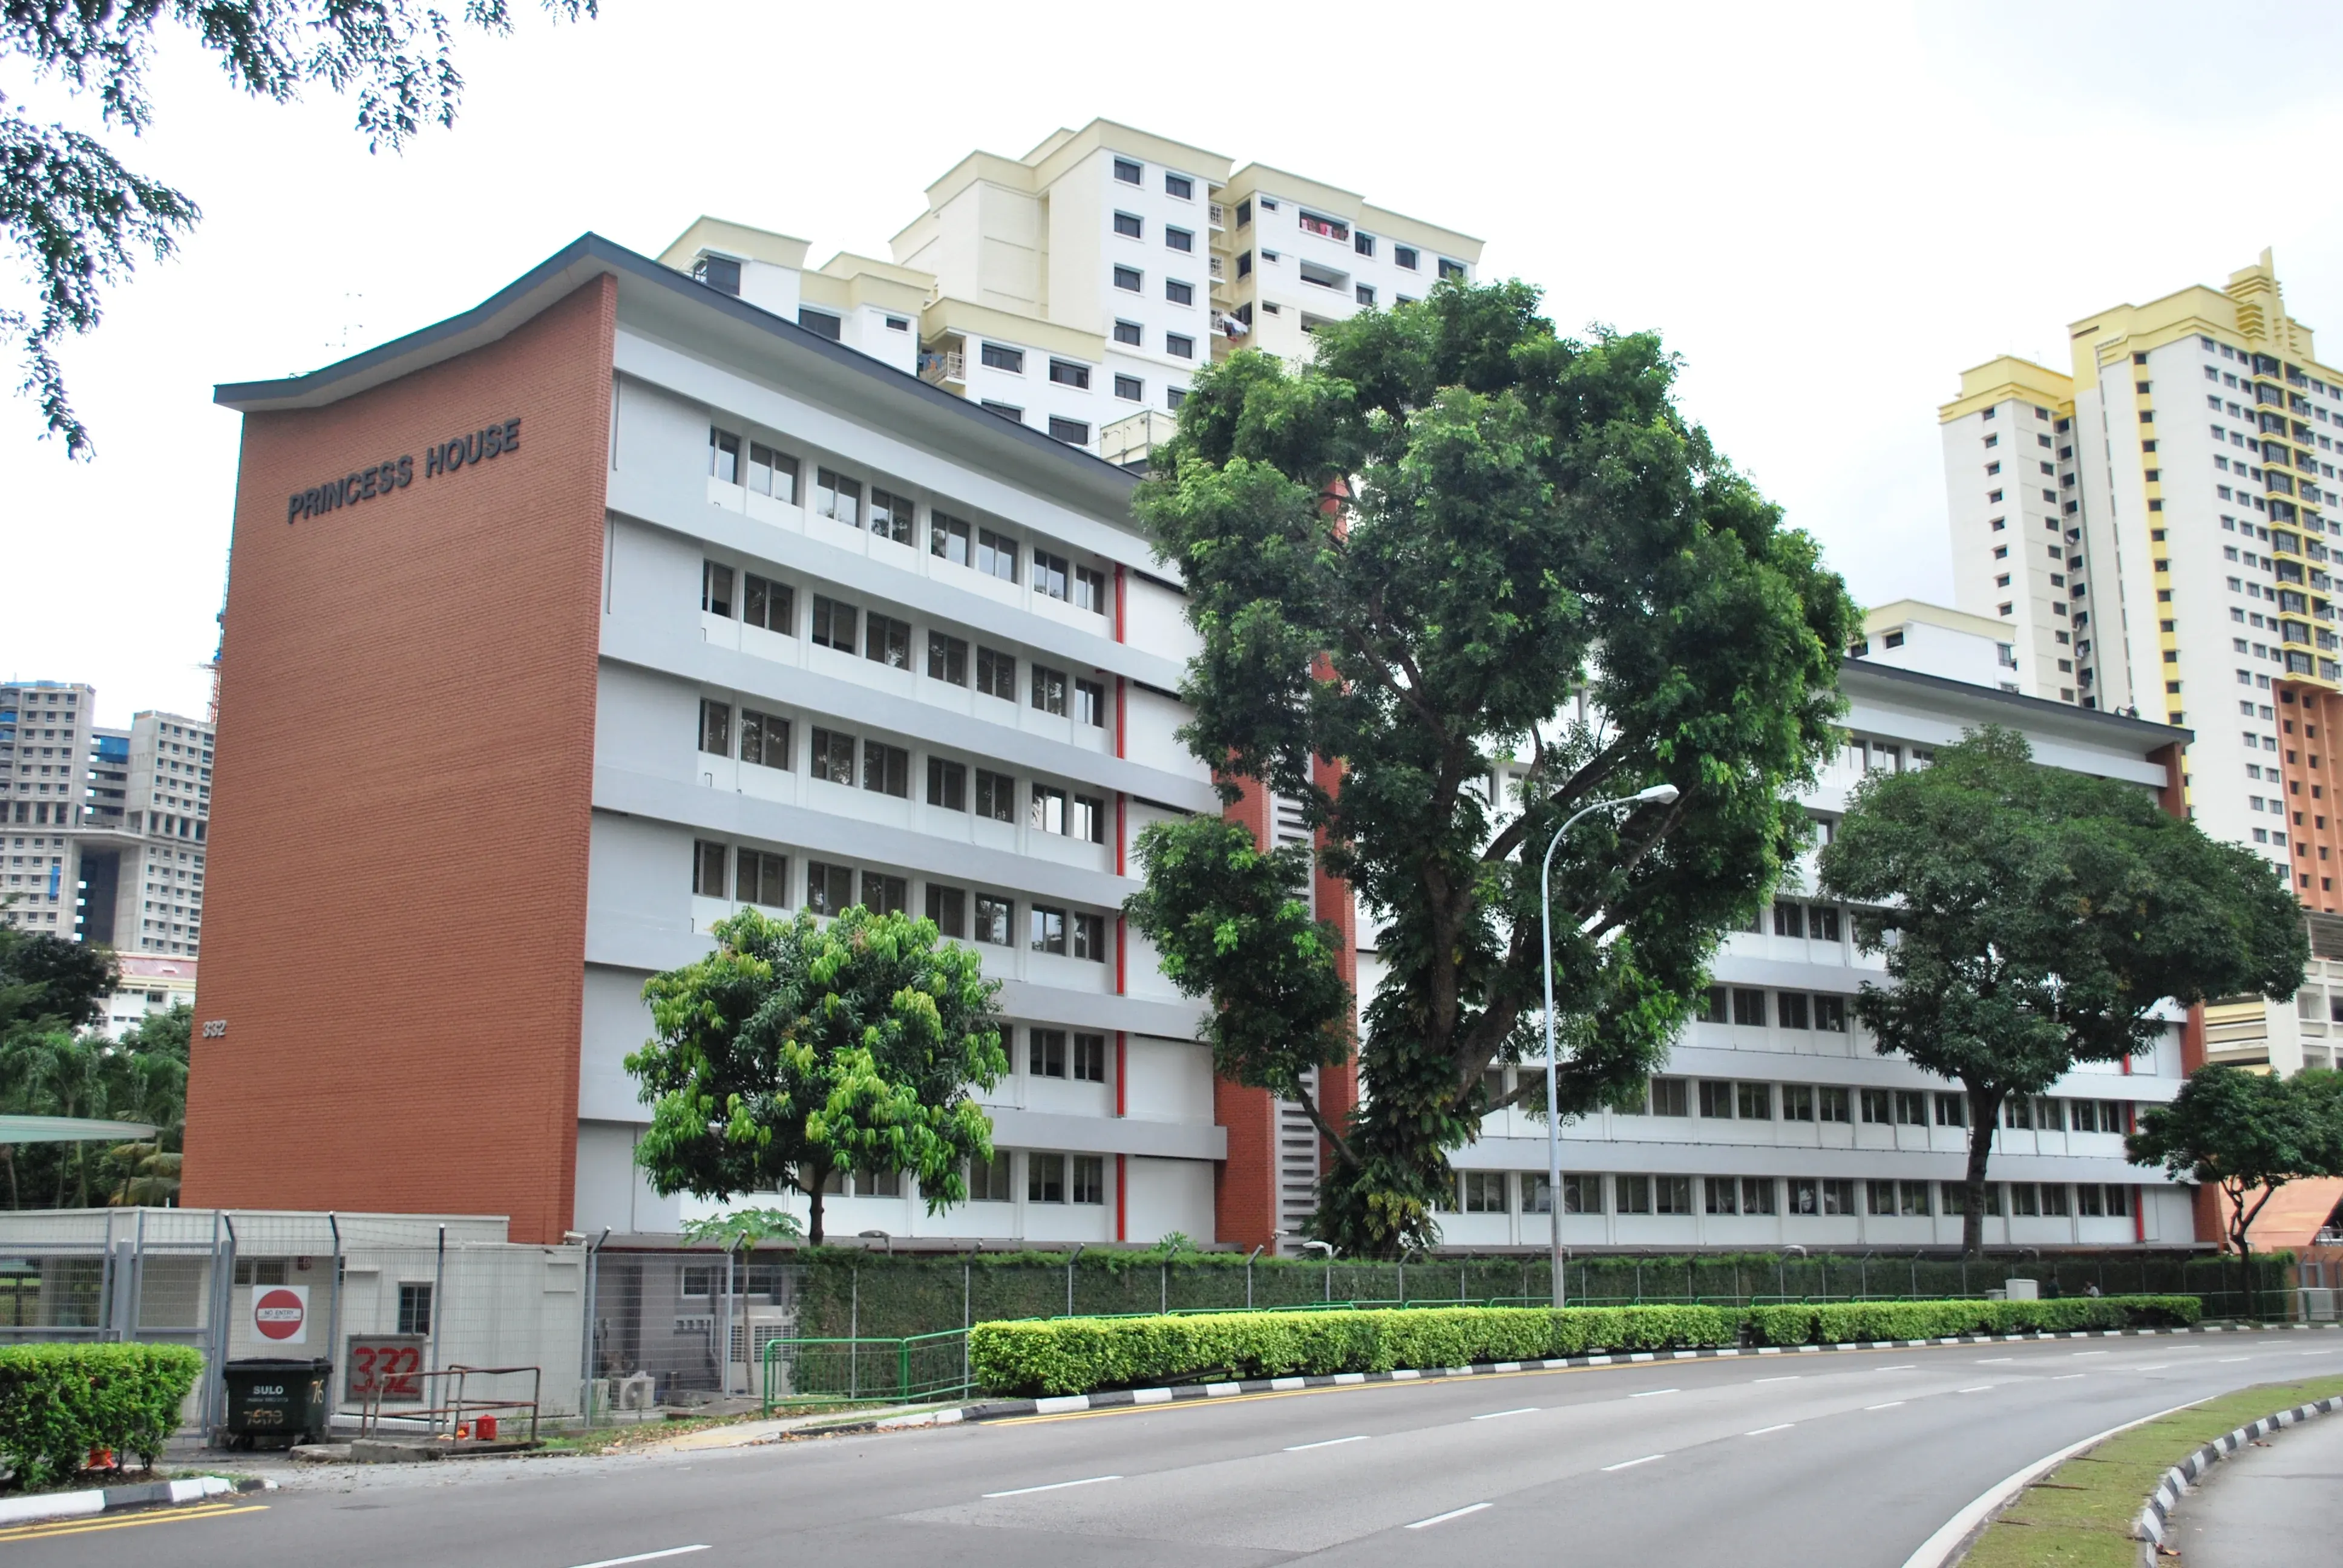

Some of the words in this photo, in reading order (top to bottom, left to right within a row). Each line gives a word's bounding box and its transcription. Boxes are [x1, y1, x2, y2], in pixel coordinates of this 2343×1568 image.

[287, 454, 413, 524] PRINCESS
[425, 417, 521, 478] HOUSE
[203, 1020, 227, 1037] 332
[353, 1347, 419, 1393] 332
[253, 1385, 284, 1395] SULO
